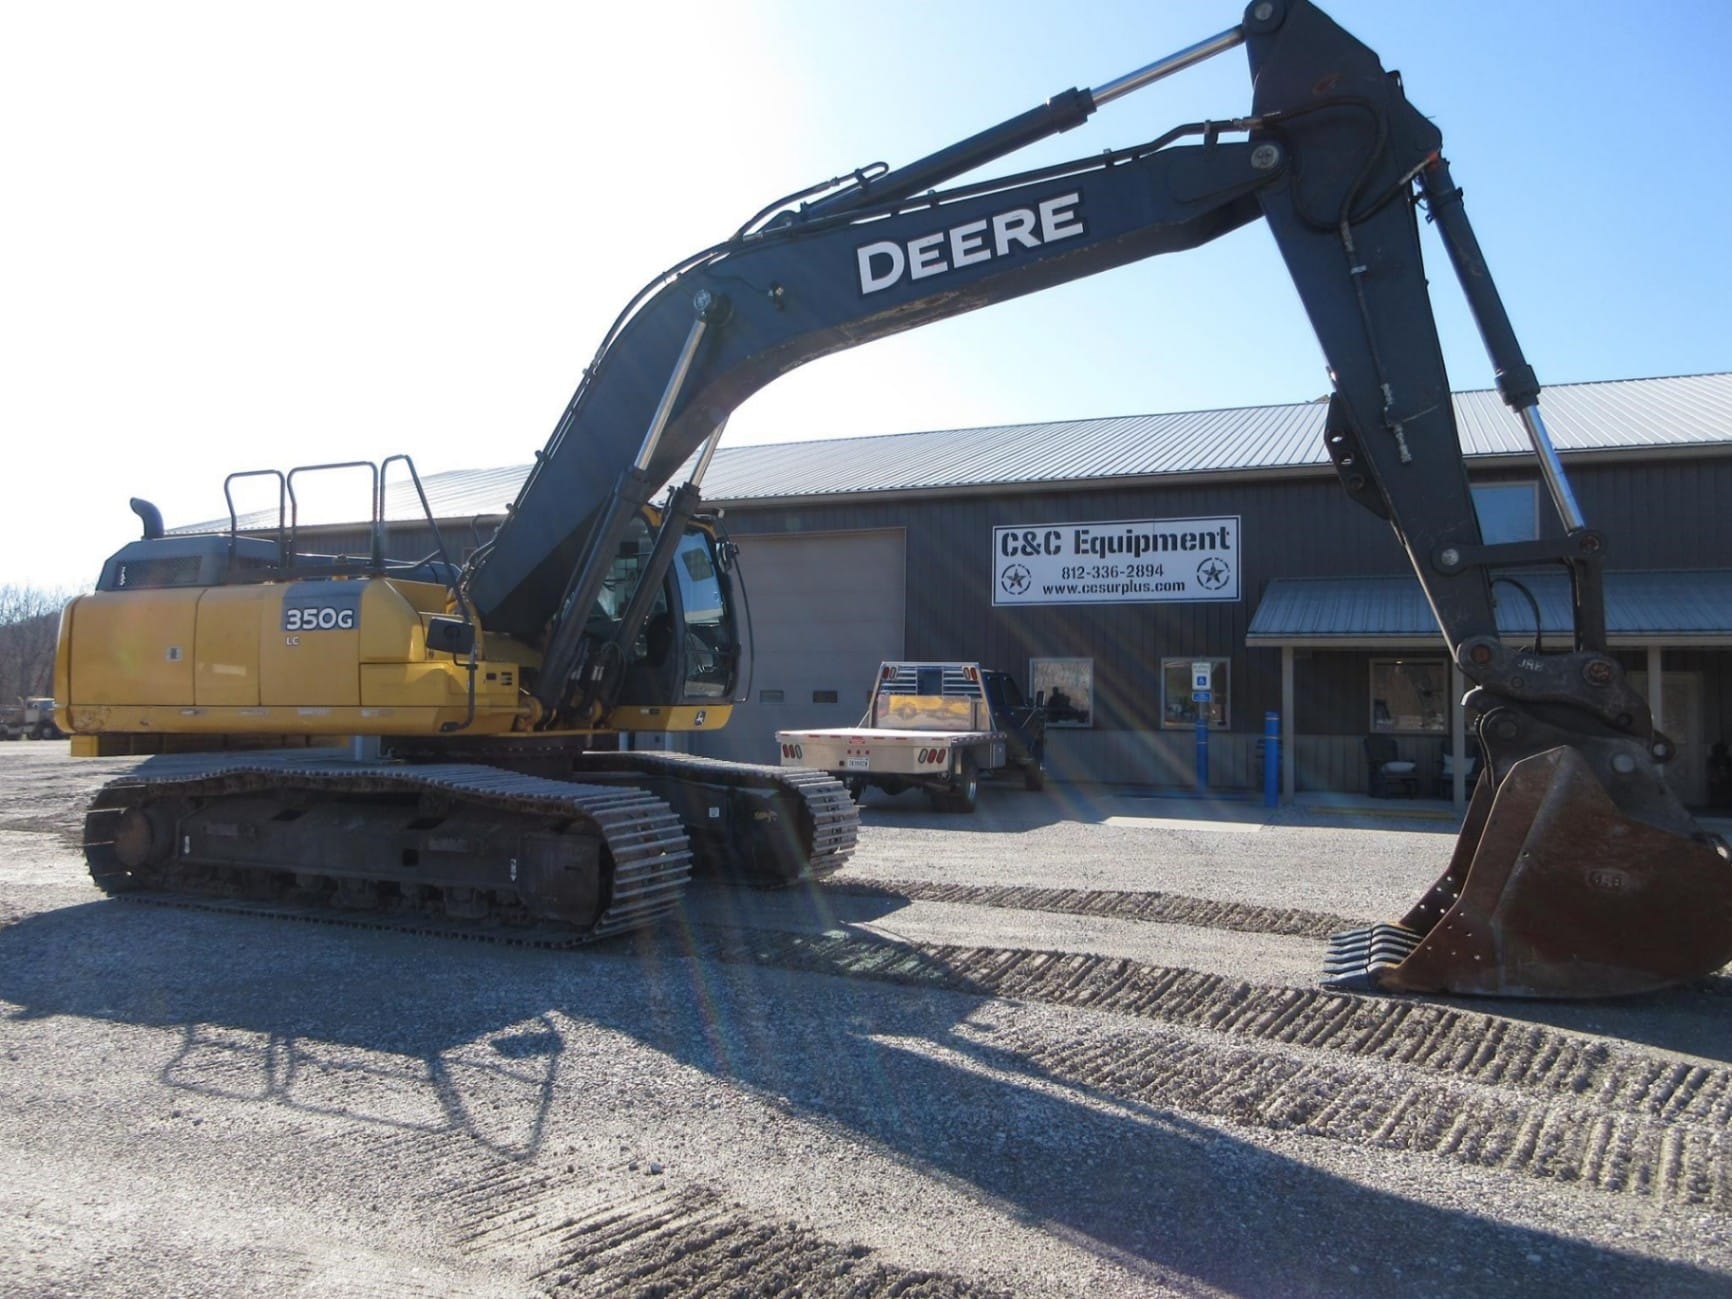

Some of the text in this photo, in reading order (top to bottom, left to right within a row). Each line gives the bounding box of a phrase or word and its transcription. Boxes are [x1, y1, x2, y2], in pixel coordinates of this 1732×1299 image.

[856, 192, 1084, 295] DEERE
[1001, 526, 1230, 559] C&C Equipment
[1061, 563, 1164, 580] 812-336-2894
[1042, 579, 1186, 596] www.ccsurplus.com
[287, 608, 353, 630] 350G
[286, 636, 299, 646] LC
